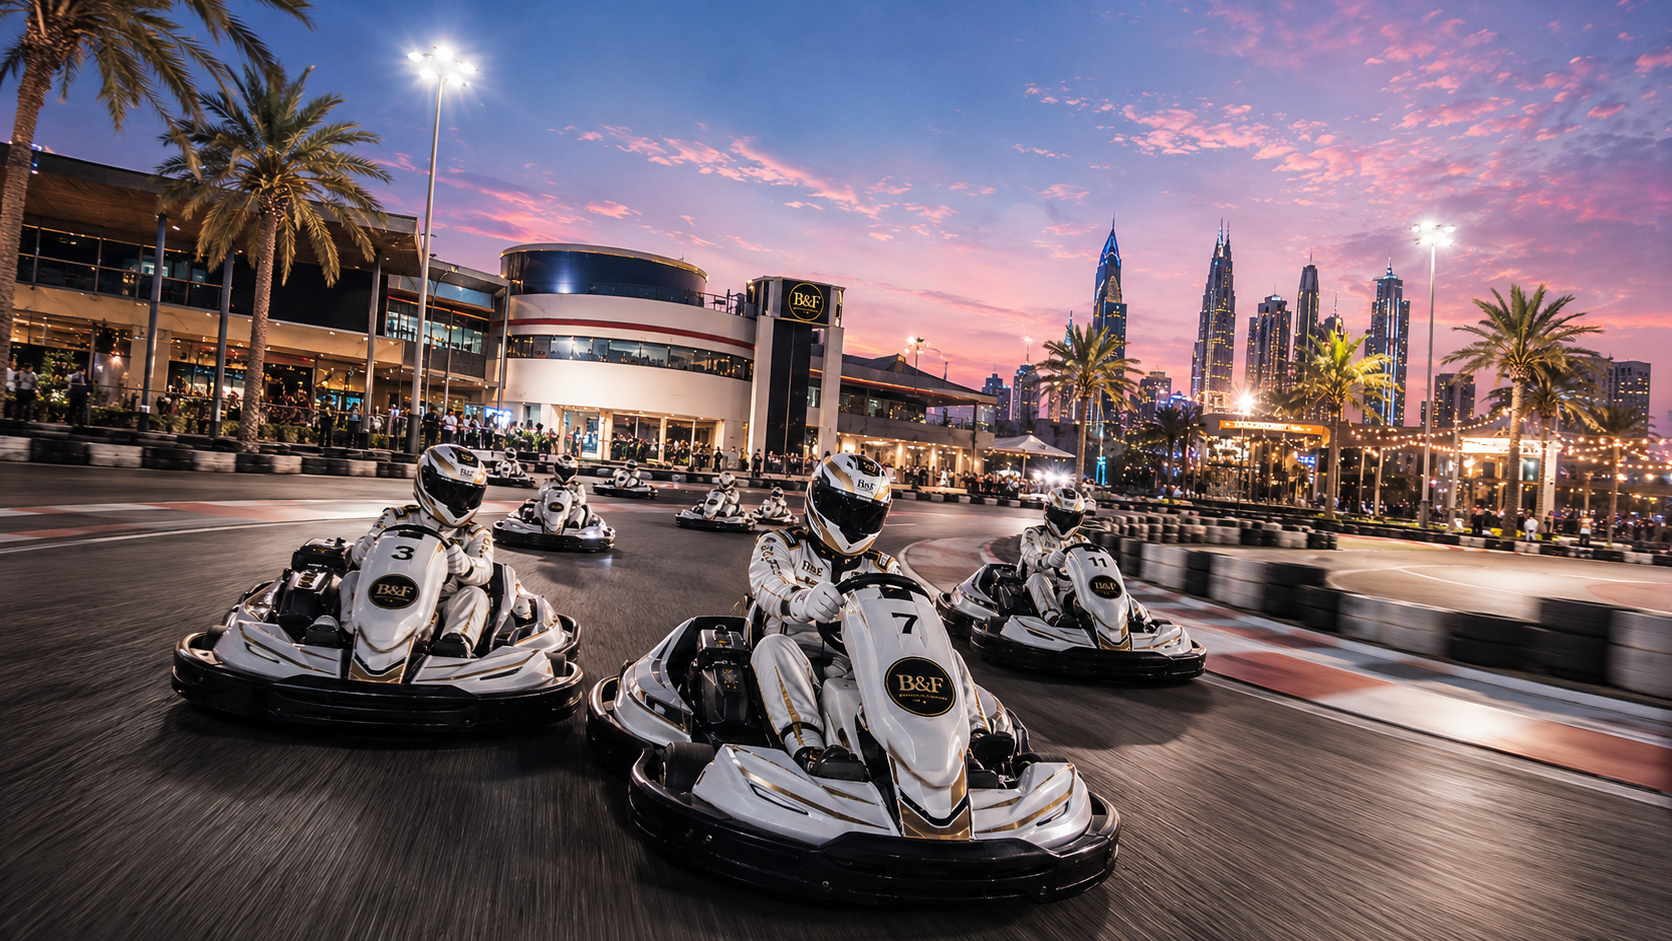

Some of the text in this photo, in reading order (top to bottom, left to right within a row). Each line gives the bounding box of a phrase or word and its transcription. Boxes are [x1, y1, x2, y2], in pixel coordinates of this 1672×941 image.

[793, 291, 821, 309] B&F
[391, 545, 415, 561] 3
[1088, 556, 1108, 568] 11
[376, 583, 413, 597] B&F
[891, 612, 919, 635] 7
[895, 673, 944, 694] B&F
